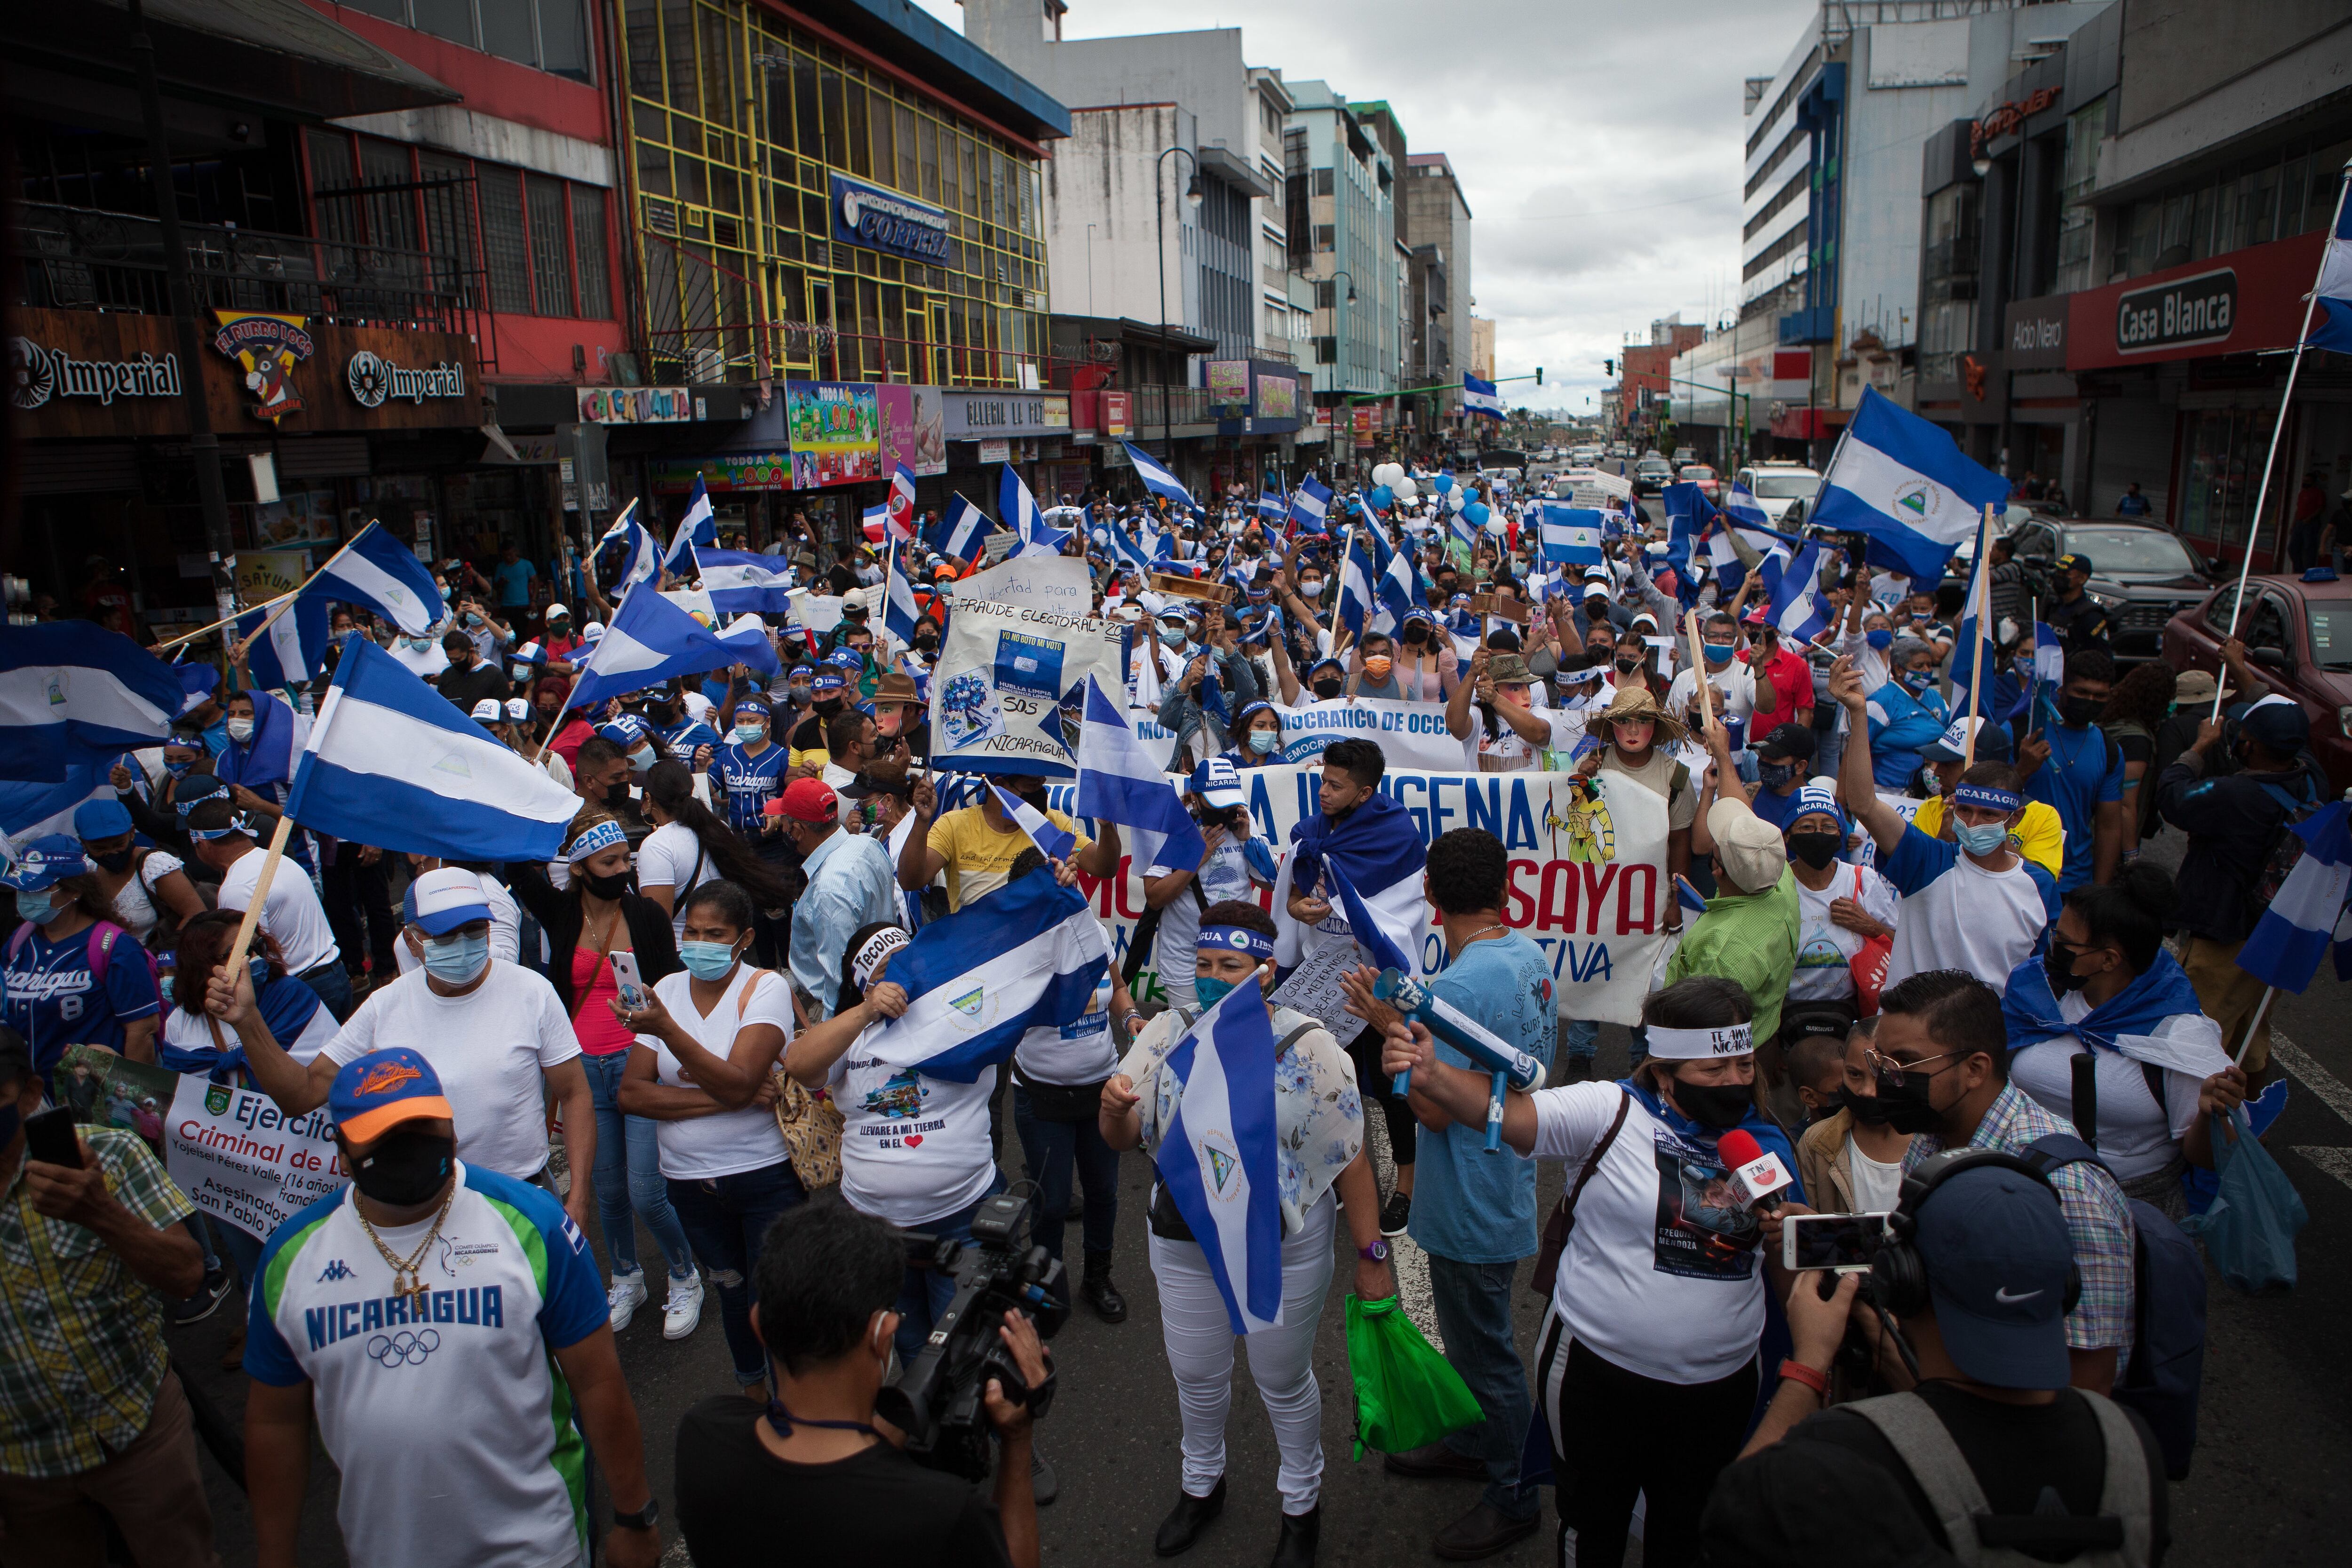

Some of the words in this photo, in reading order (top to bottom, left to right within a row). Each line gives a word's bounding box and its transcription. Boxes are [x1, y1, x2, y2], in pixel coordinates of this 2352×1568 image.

[2120, 303, 2158, 344] Casa
[2165, 291, 2231, 337] Blanca
[215, 332, 235, 354] EL
[230, 321, 279, 342] BURRO
[280, 323, 314, 356] LOCO
[2012, 321, 2036, 350] Aldo
[2036, 318, 2063, 349] Nero
[52, 348, 182, 405] Imperial
[387, 360, 465, 405] Imperial
[819, 387, 837, 402] TODO
[839, 388, 845, 402] A
[821, 404, 857, 433] 1.000
[1012, 402, 1023, 424] LA
[725, 456, 753, 467] TODO
[756, 454, 765, 465] A
[727, 466, 784, 486] 1.000
[1044, 584, 1077, 599] para
[959, 597, 1015, 618] FRAUDE
[1021, 609, 1097, 632] ELECTORAL
[1002, 631, 1010, 640] YO
[1011, 633, 1020, 642] NO
[1020, 634, 1036, 645] BOTO
[1037, 638, 1045, 648] MI
[1046, 640, 1062, 651] VOTO
[999, 681, 1026, 692] HUELLA
[999, 686, 1032, 697] CONCIENCIA
[1003, 696, 1038, 715] SOS
[1280, 708, 1378, 732] MOCRATICO
[1381, 711, 1404, 731] DE
[984, 735, 1065, 760] NICARAGUA
[722, 764, 778, 794] Nicaragua
[1955, 788, 2020, 807] NICARAGUA
[1796, 803, 1840, 817] NICARAGUA
[102, 930, 113, 949] DELTA
[1284, 950, 1328, 998] GOBIERNO
[1303, 952, 1347, 1000] METERNOS
[1511, 962, 1535, 1019] LAGUNA
[60, 994, 84, 1021] 8
[1076, 1024, 1101, 1038] ELECTORAL
[1077, 1015, 1089, 1027] MÁS
[1521, 1016, 1541, 1036] SURF
[1710, 1031, 1725, 1044] TE
[860, 1125, 891, 1136] LLEVARE
[892, 1124, 899, 1135] A
[900, 1123, 913, 1134] MI
[914, 1119, 946, 1133] TIERRA
[179, 1120, 285, 1164] Criminal
[290, 1148, 322, 1172] de
[880, 1139, 890, 1149] EN
[892, 1138, 902, 1148] EL
[172, 1138, 215, 1162] Yojeisel
[218, 1155, 249, 1173] Pérez
[253, 1164, 282, 1183] Valle
[284, 1172, 303, 1189] (16
[1747, 1159, 1772, 1176] TND
[192, 1187, 220, 1210] San
[225, 1201, 264, 1232] Pablo
[204, 1177, 288, 1224] Asesinados
[1658, 1236, 1697, 1250] MENDOZA
[1659, 1227, 1697, 1240] EZEQUIEL
[304, 1285, 505, 1352] NICARAGUA
